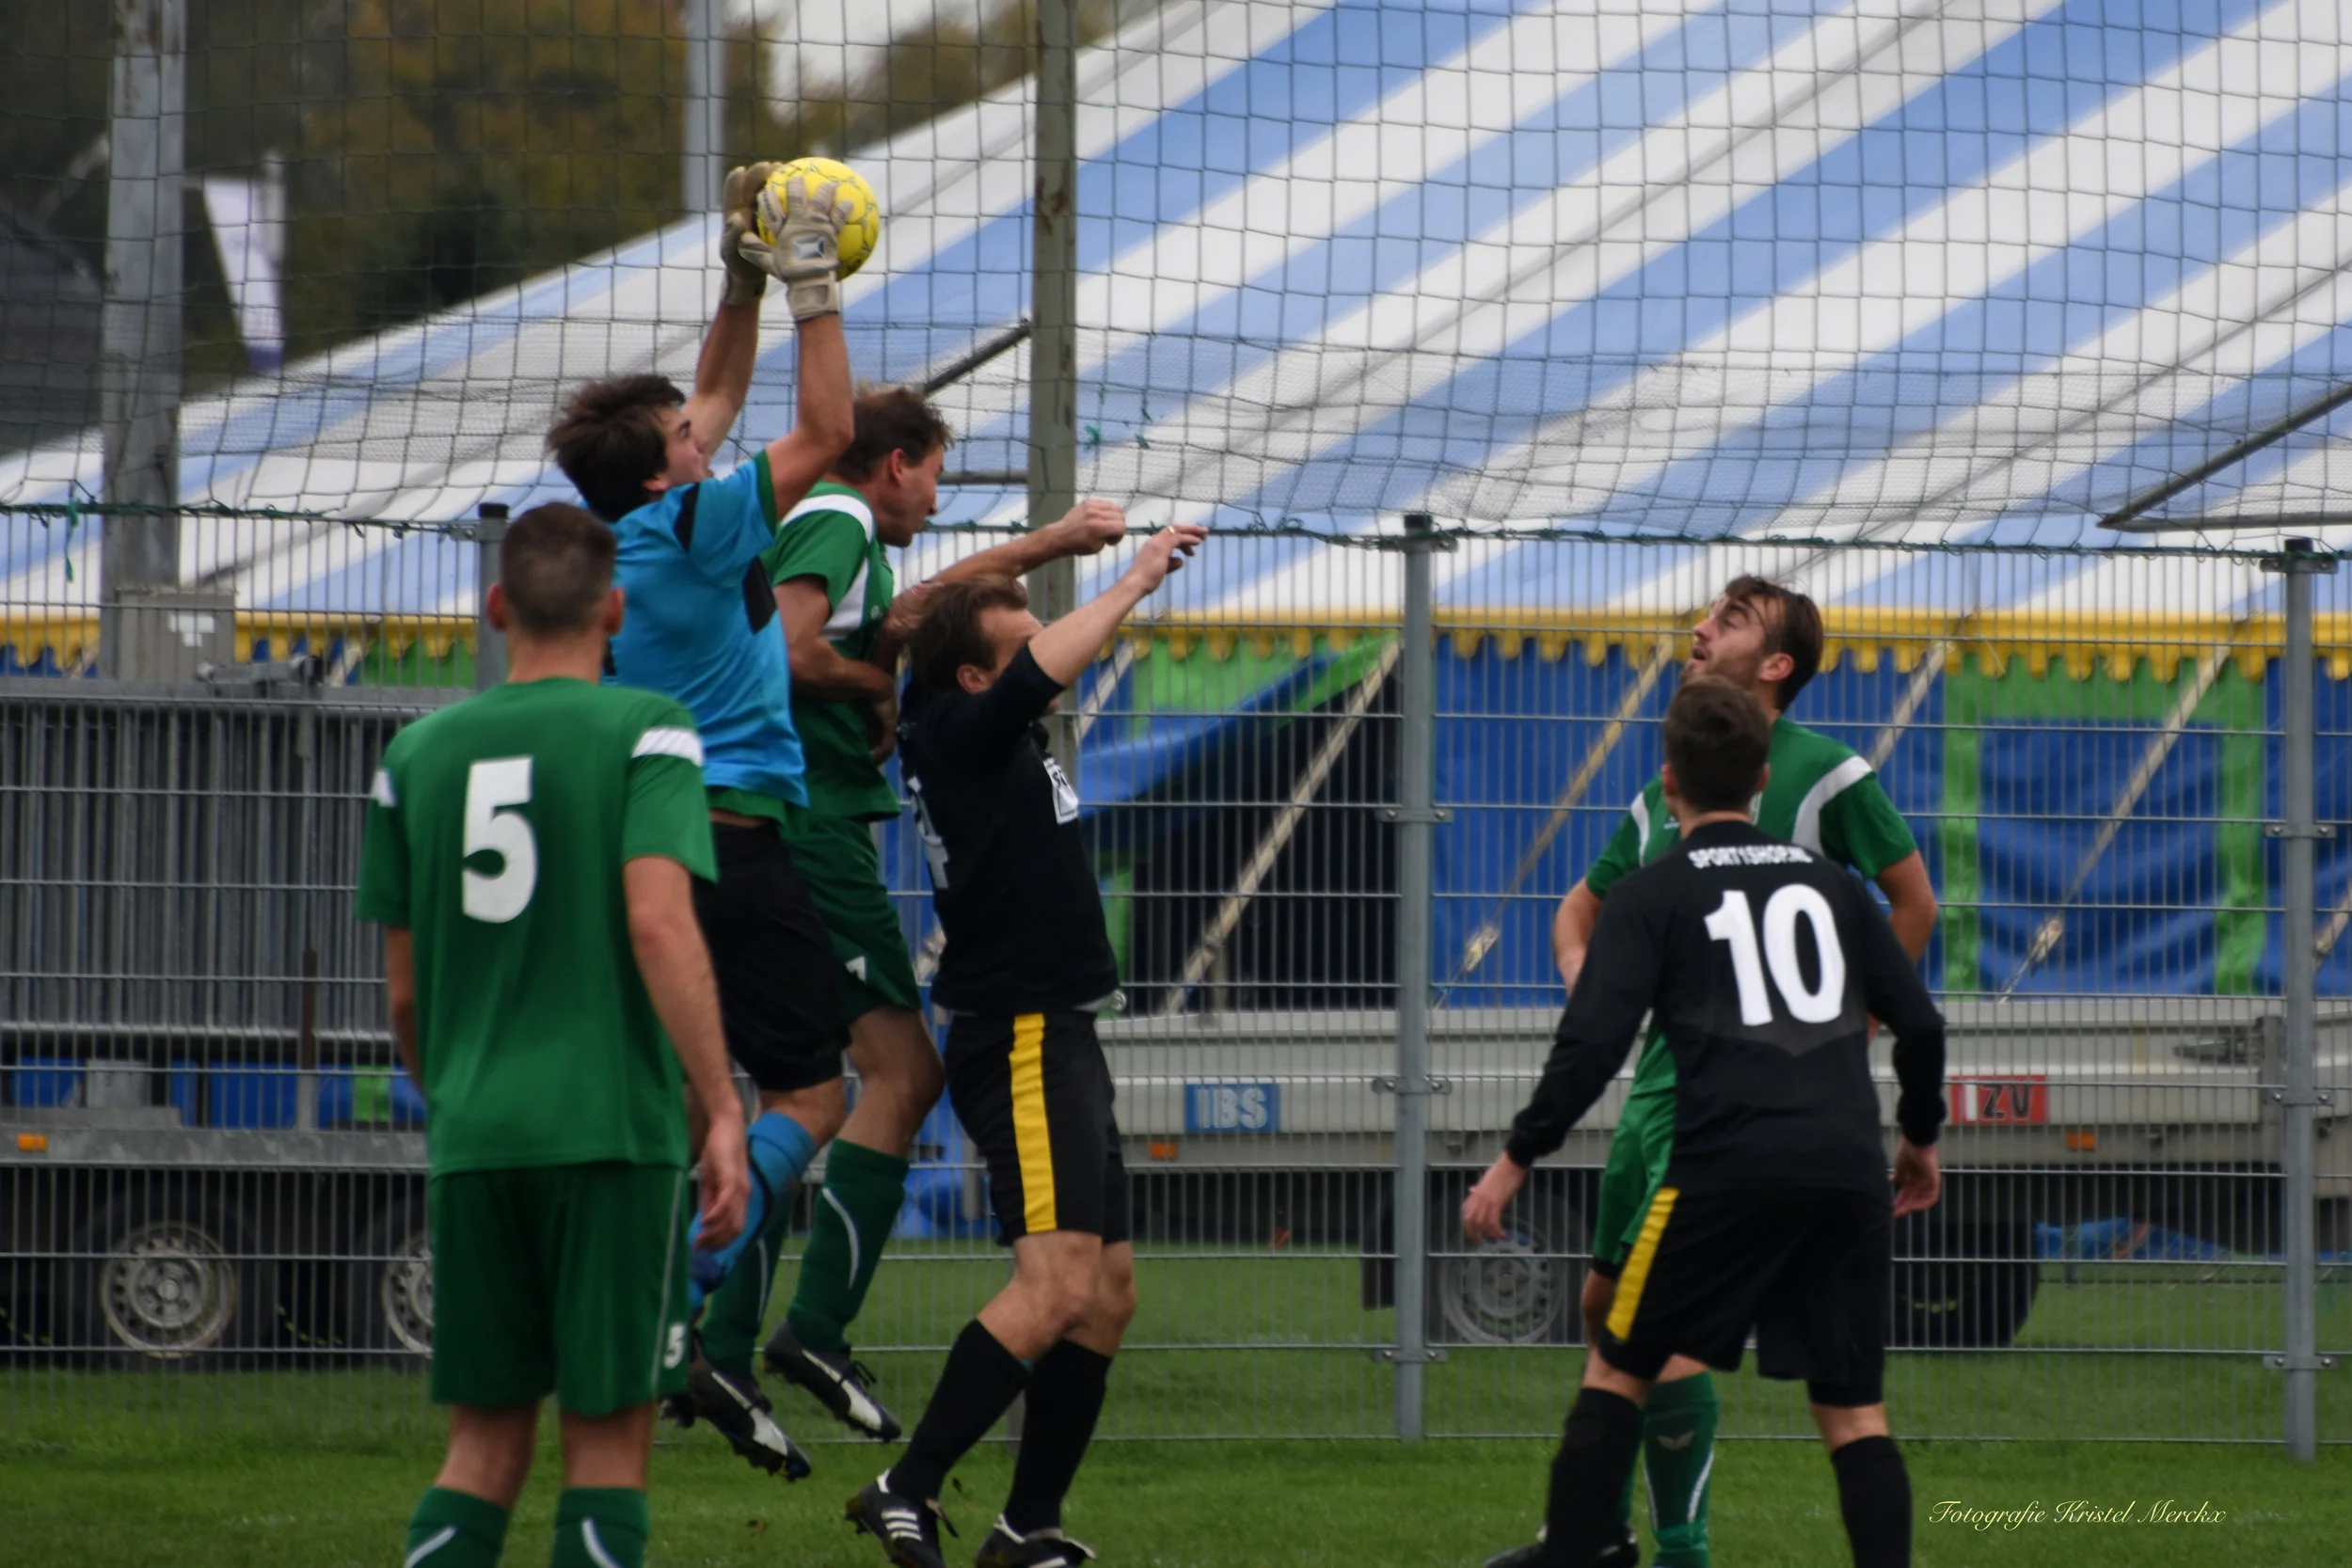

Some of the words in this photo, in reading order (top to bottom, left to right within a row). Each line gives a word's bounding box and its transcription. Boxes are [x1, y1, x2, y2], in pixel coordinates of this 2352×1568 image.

[462, 755, 537, 924] 5
[1704, 883, 1846, 1027] 10
[1198, 1087, 1267, 1129] IBS
[664, 1323, 686, 1370] 5
